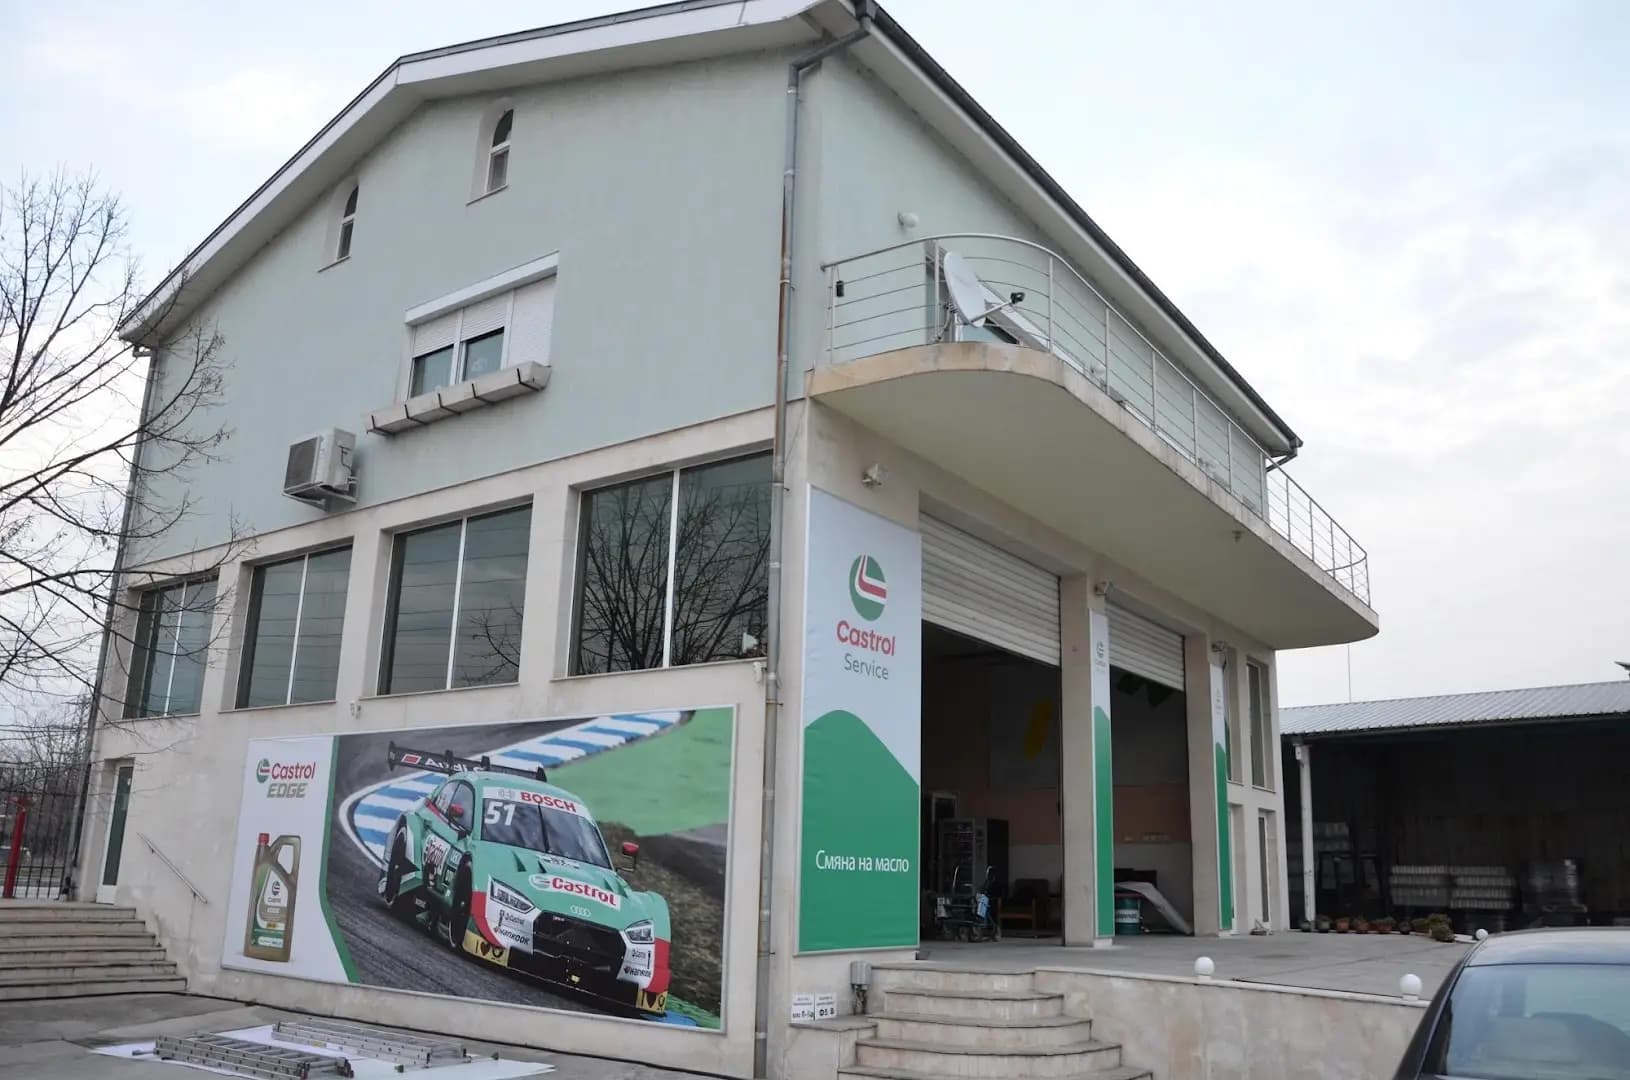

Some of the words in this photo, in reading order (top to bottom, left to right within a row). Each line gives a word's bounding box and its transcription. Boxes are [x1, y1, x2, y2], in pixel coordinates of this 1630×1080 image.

[836, 620, 896, 656] Castrol
[844, 653, 889, 680] Service
[271, 761, 316, 780] Castrol
[266, 782, 309, 799] EDGE
[520, 791, 577, 813] BOSCH
[484, 801, 516, 826] 51
[815, 849, 856, 871] Смяна
[858, 857, 873, 871] на
[874, 857, 910, 873] масло
[552, 877, 617, 906] Castrol
